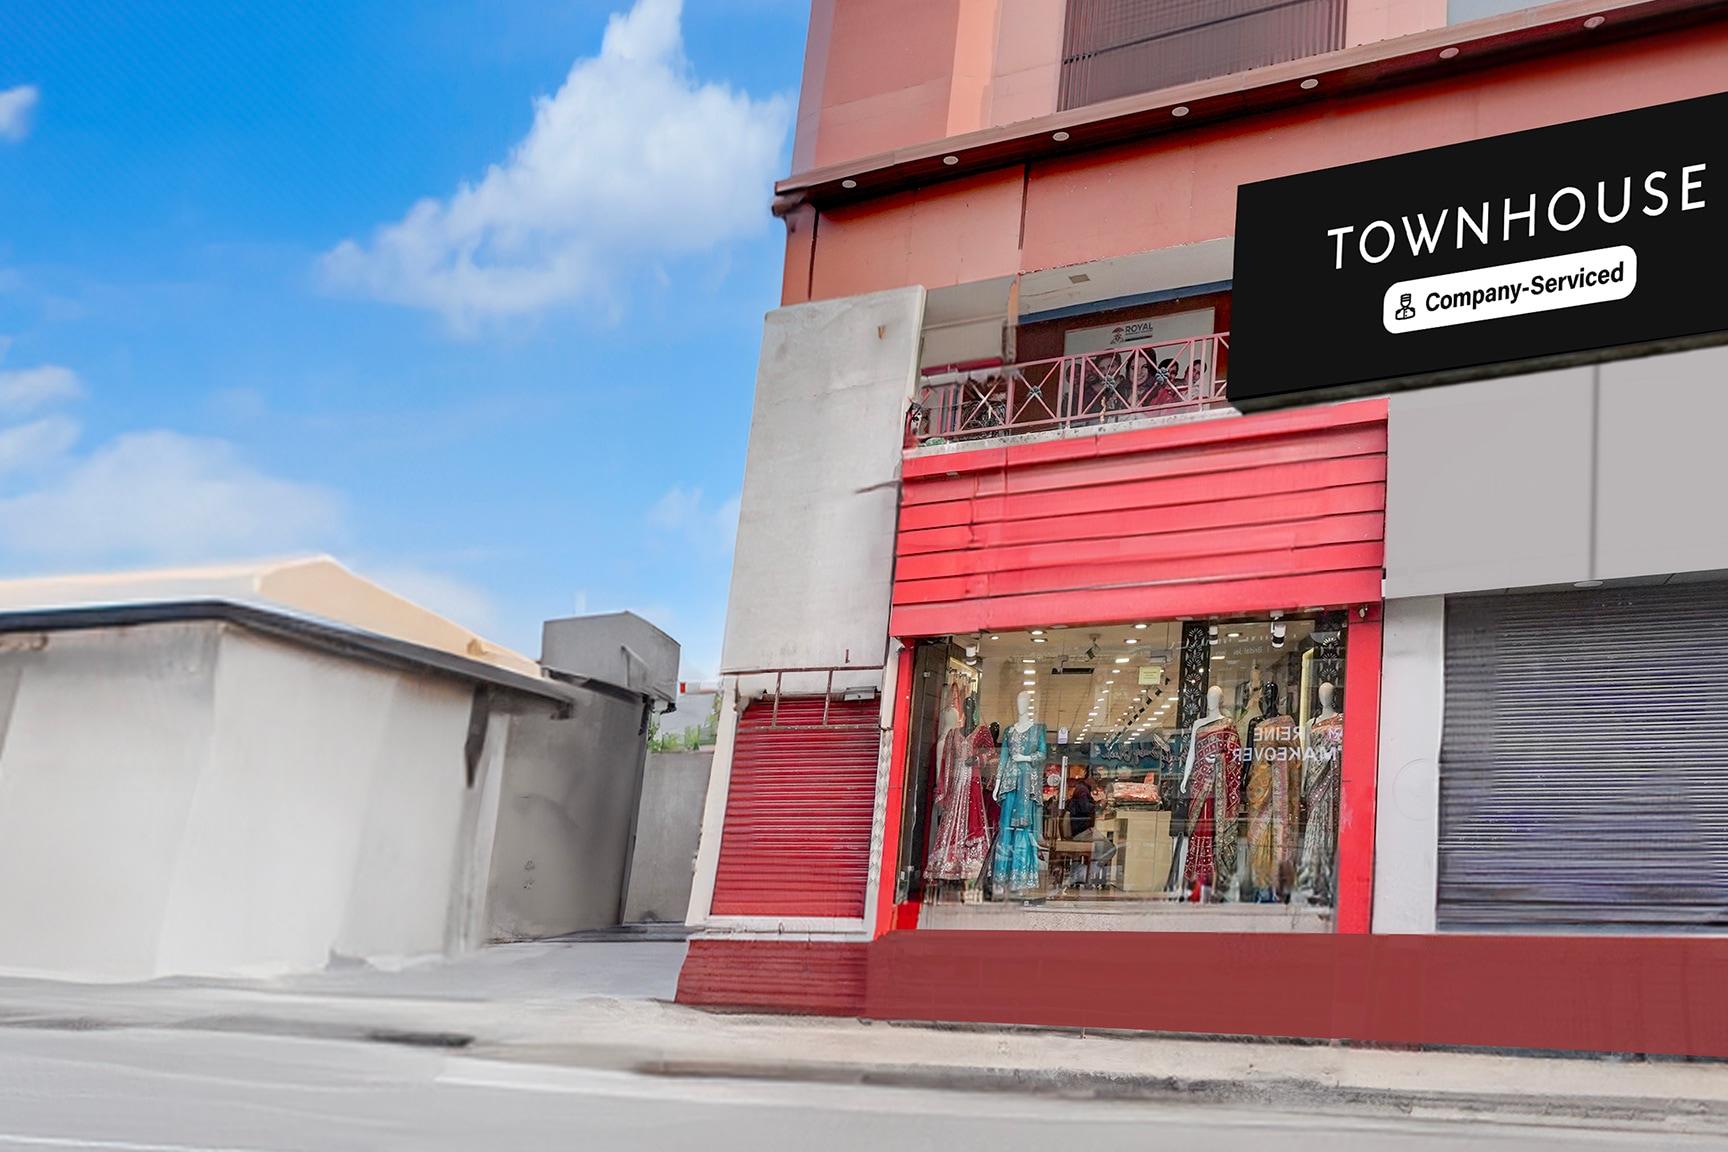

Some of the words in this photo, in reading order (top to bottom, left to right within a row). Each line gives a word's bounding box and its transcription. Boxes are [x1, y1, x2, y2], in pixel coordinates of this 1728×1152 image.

[1327, 163, 1707, 270] TOWNHOUSE
[1425, 260, 1624, 313] Company-Serviced
[1125, 323, 1153, 333] ROYAL
